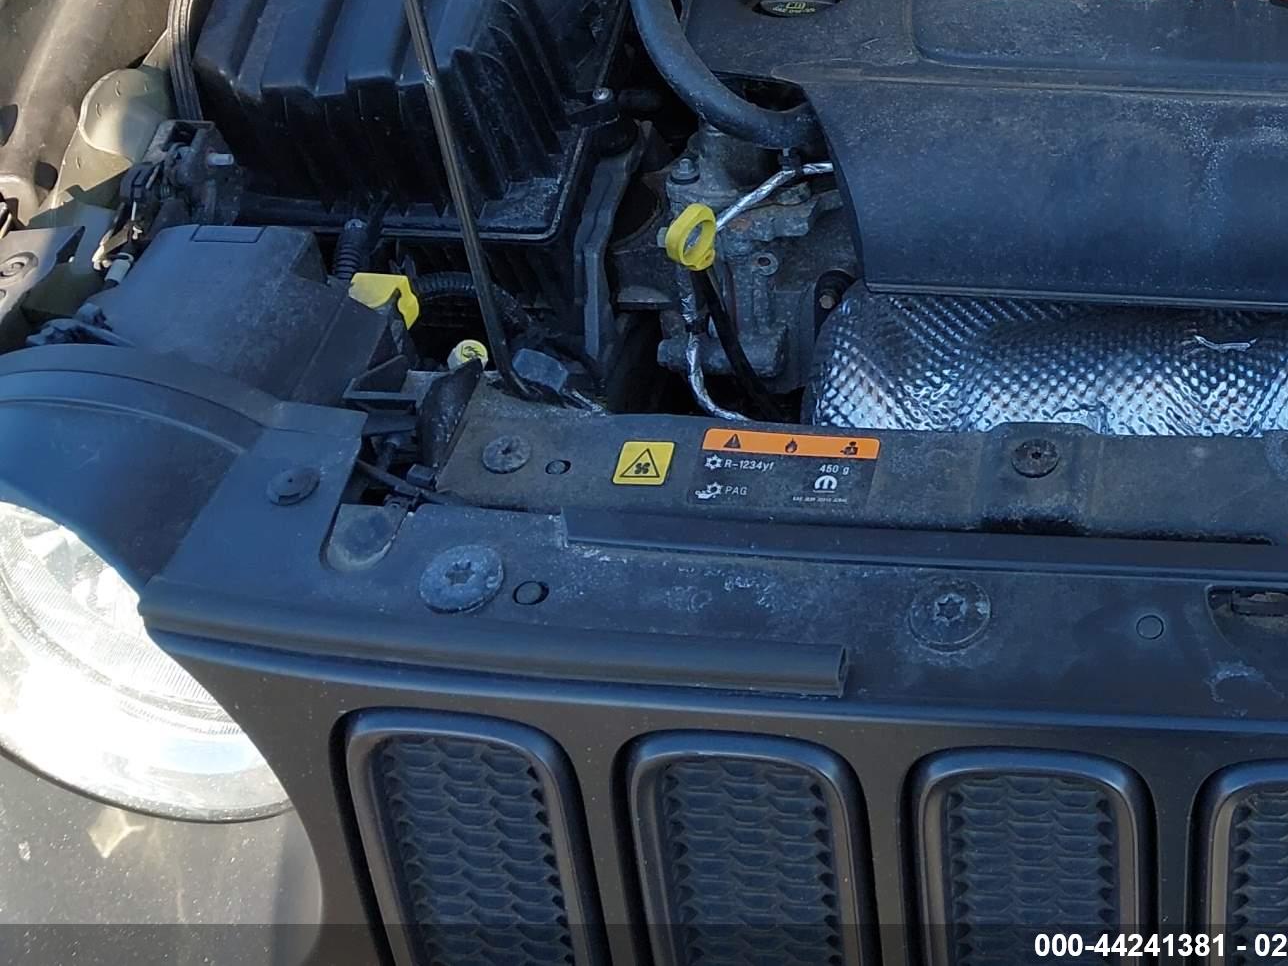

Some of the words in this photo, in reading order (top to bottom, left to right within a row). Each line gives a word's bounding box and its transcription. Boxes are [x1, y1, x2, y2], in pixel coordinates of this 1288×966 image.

[723, 459, 775, 472] R-1234yf
[819, 464, 839, 474] 450
[842, 466, 850, 476] g
[724, 486, 748, 496] PAG
